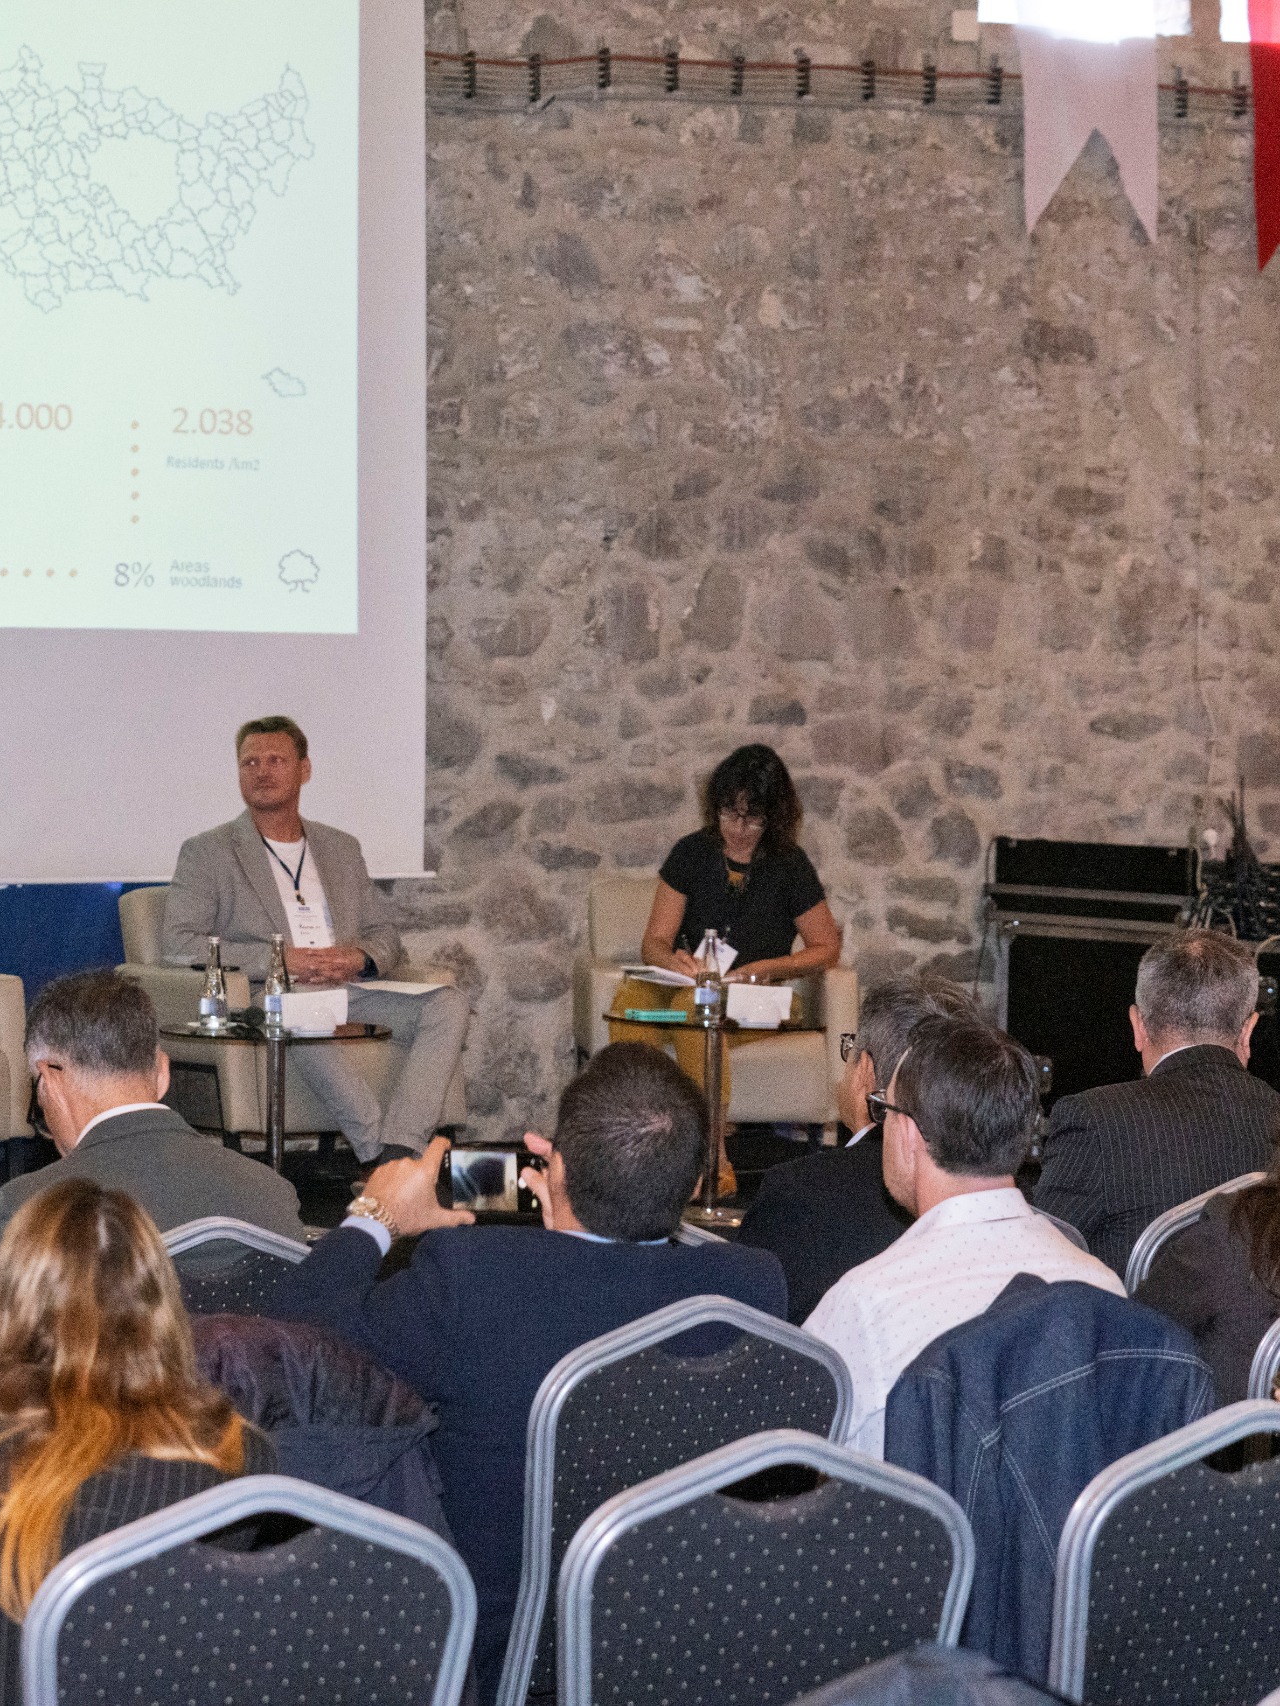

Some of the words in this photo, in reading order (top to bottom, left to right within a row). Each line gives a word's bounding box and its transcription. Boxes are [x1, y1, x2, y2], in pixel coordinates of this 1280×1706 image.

[172, 407, 254, 436] 2.038
[166, 456, 225, 471] Residents
[169, 559, 210, 573] Areas
[114, 561, 155, 588] 8%
[169, 575, 243, 589] woodlands
